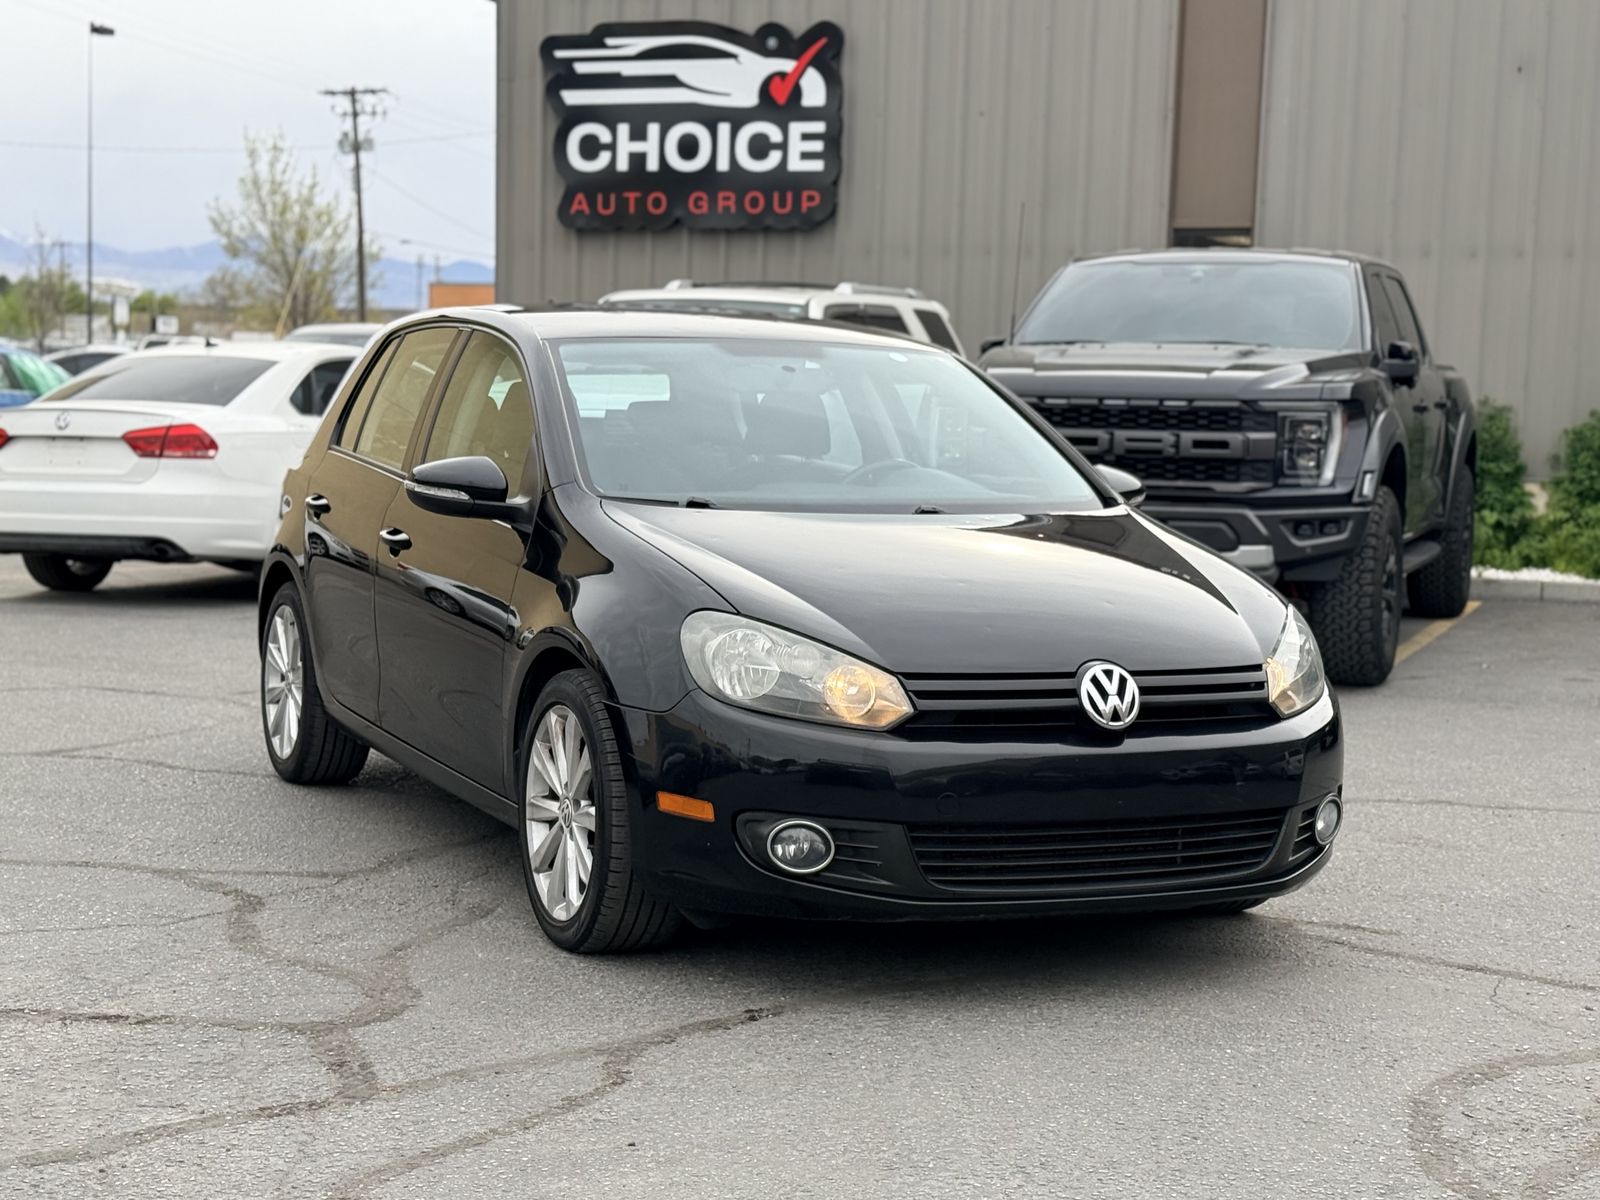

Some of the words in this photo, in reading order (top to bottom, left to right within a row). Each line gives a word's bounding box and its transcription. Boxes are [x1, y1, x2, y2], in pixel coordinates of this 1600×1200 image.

[565, 120, 827, 173] CHOICE
[569, 191, 669, 216] AUTO
[687, 189, 823, 216] GROUP
[1060, 427, 1249, 460] ORD
[1081, 665, 1139, 727] VW
